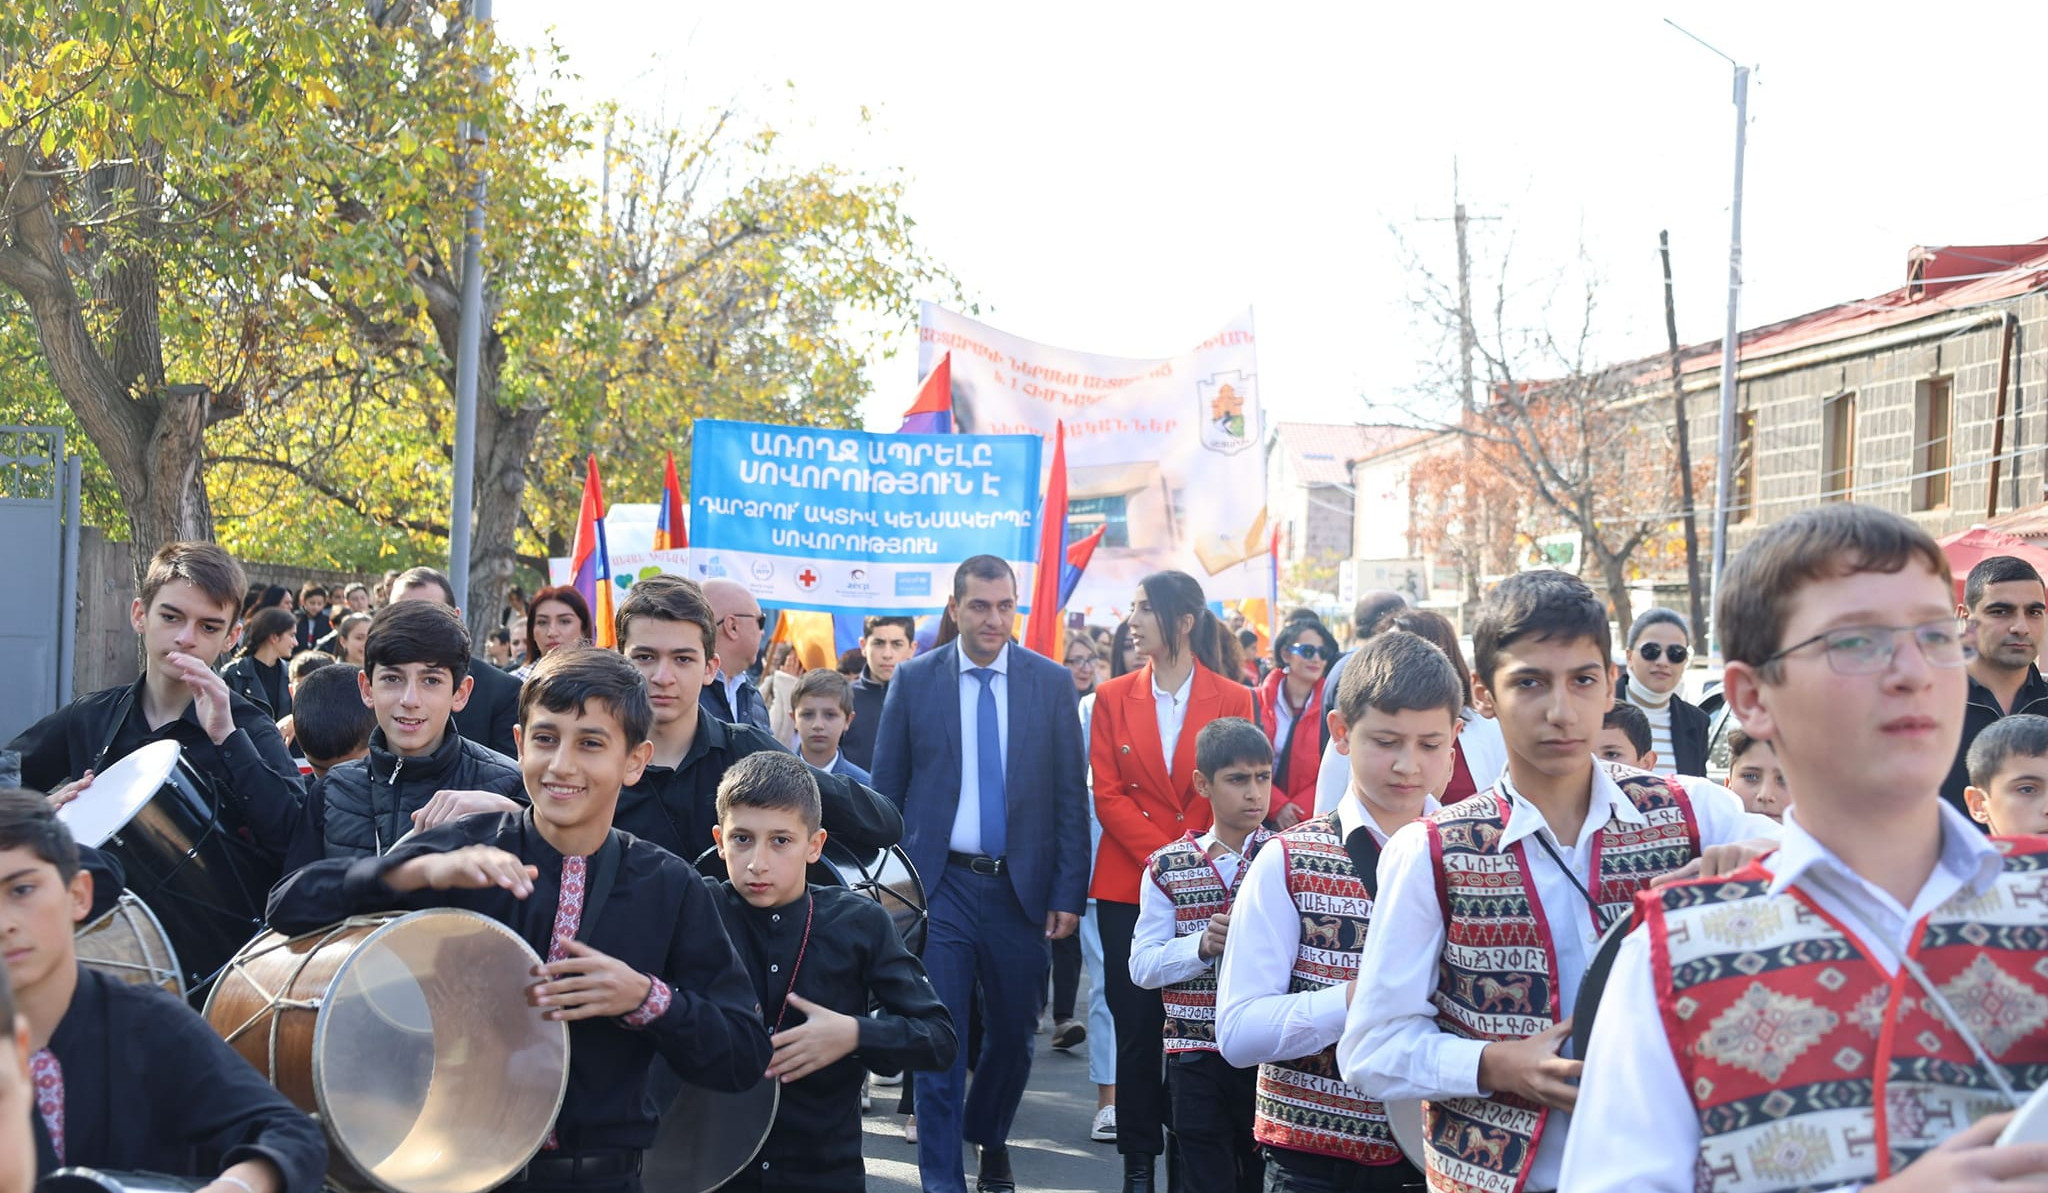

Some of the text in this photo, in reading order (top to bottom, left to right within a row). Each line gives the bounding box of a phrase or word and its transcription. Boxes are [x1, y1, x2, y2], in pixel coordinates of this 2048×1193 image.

[750, 431, 993, 469] ԱՌՈՂՋ ԱՊՐԵԼԸ
[739, 459, 1001, 497] ՍՈՎՈՐՈՒԹՅՈՒՆ Է
[804, 505, 879, 526] ԱԿՏԻՎ
[884, 510, 1032, 529] ԿԵՆՍԱԿԵՐՊԸ
[771, 527, 939, 554] ՍՈՎՈՐՈՒԹՅՈՒՆ
